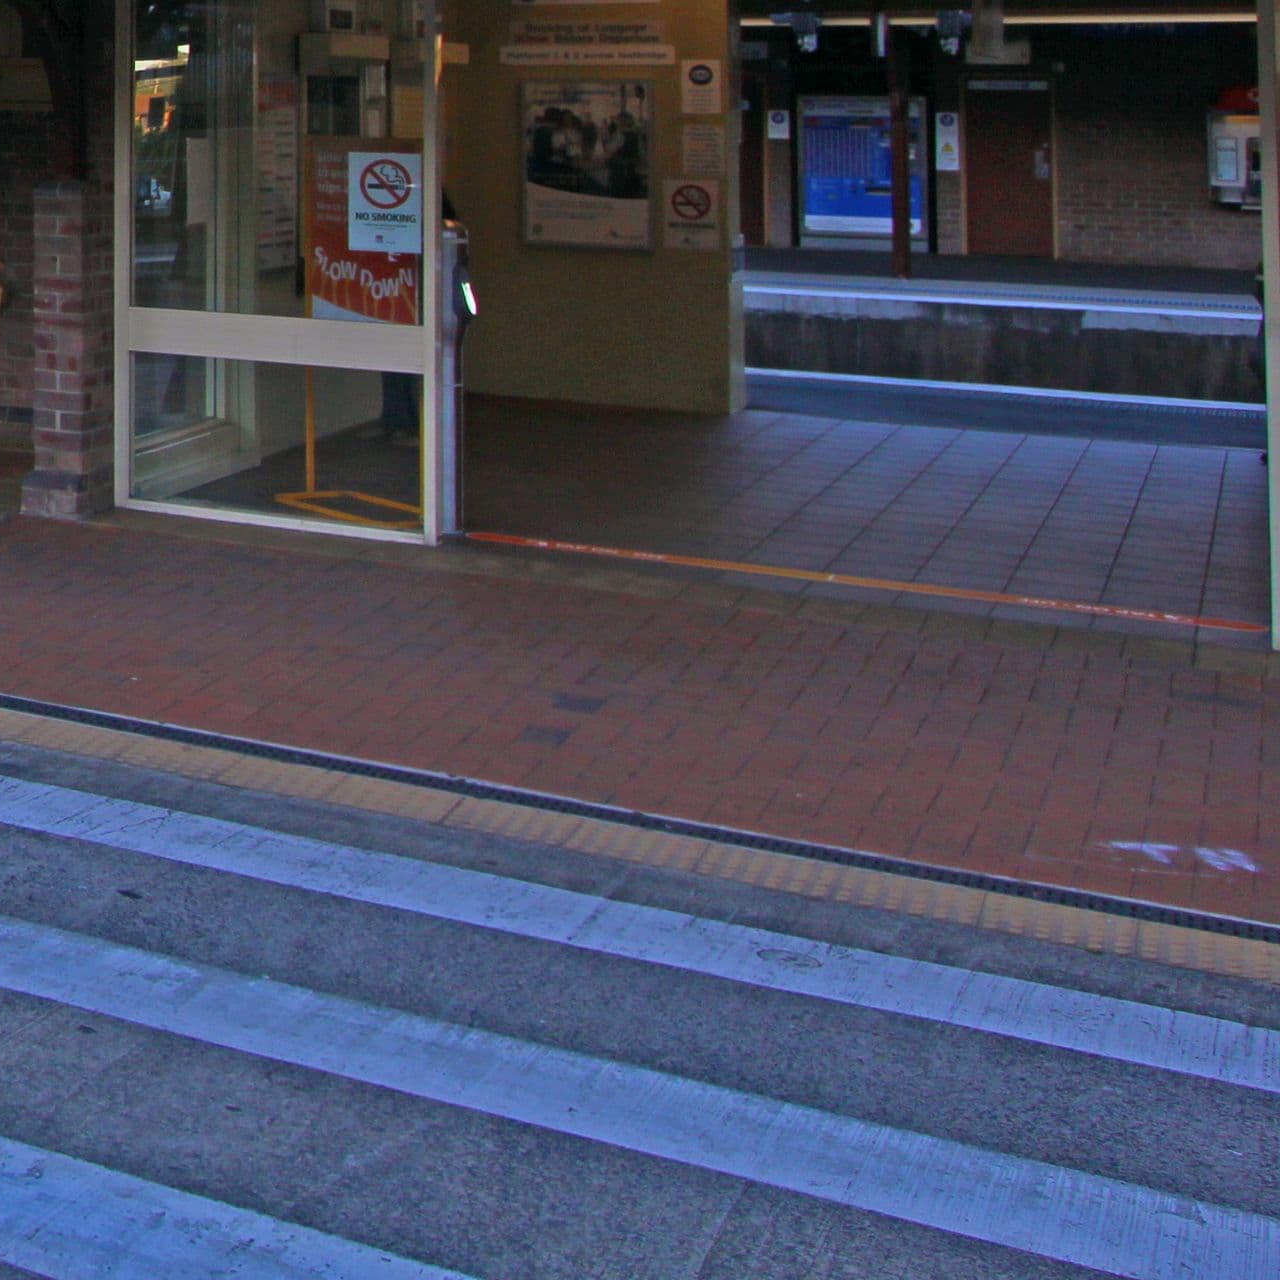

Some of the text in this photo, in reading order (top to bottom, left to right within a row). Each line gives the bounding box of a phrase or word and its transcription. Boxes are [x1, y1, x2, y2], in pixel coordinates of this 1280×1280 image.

[355, 212, 417, 223] NO SMOKING
[315, 247, 414, 300] SLOW DOWN
